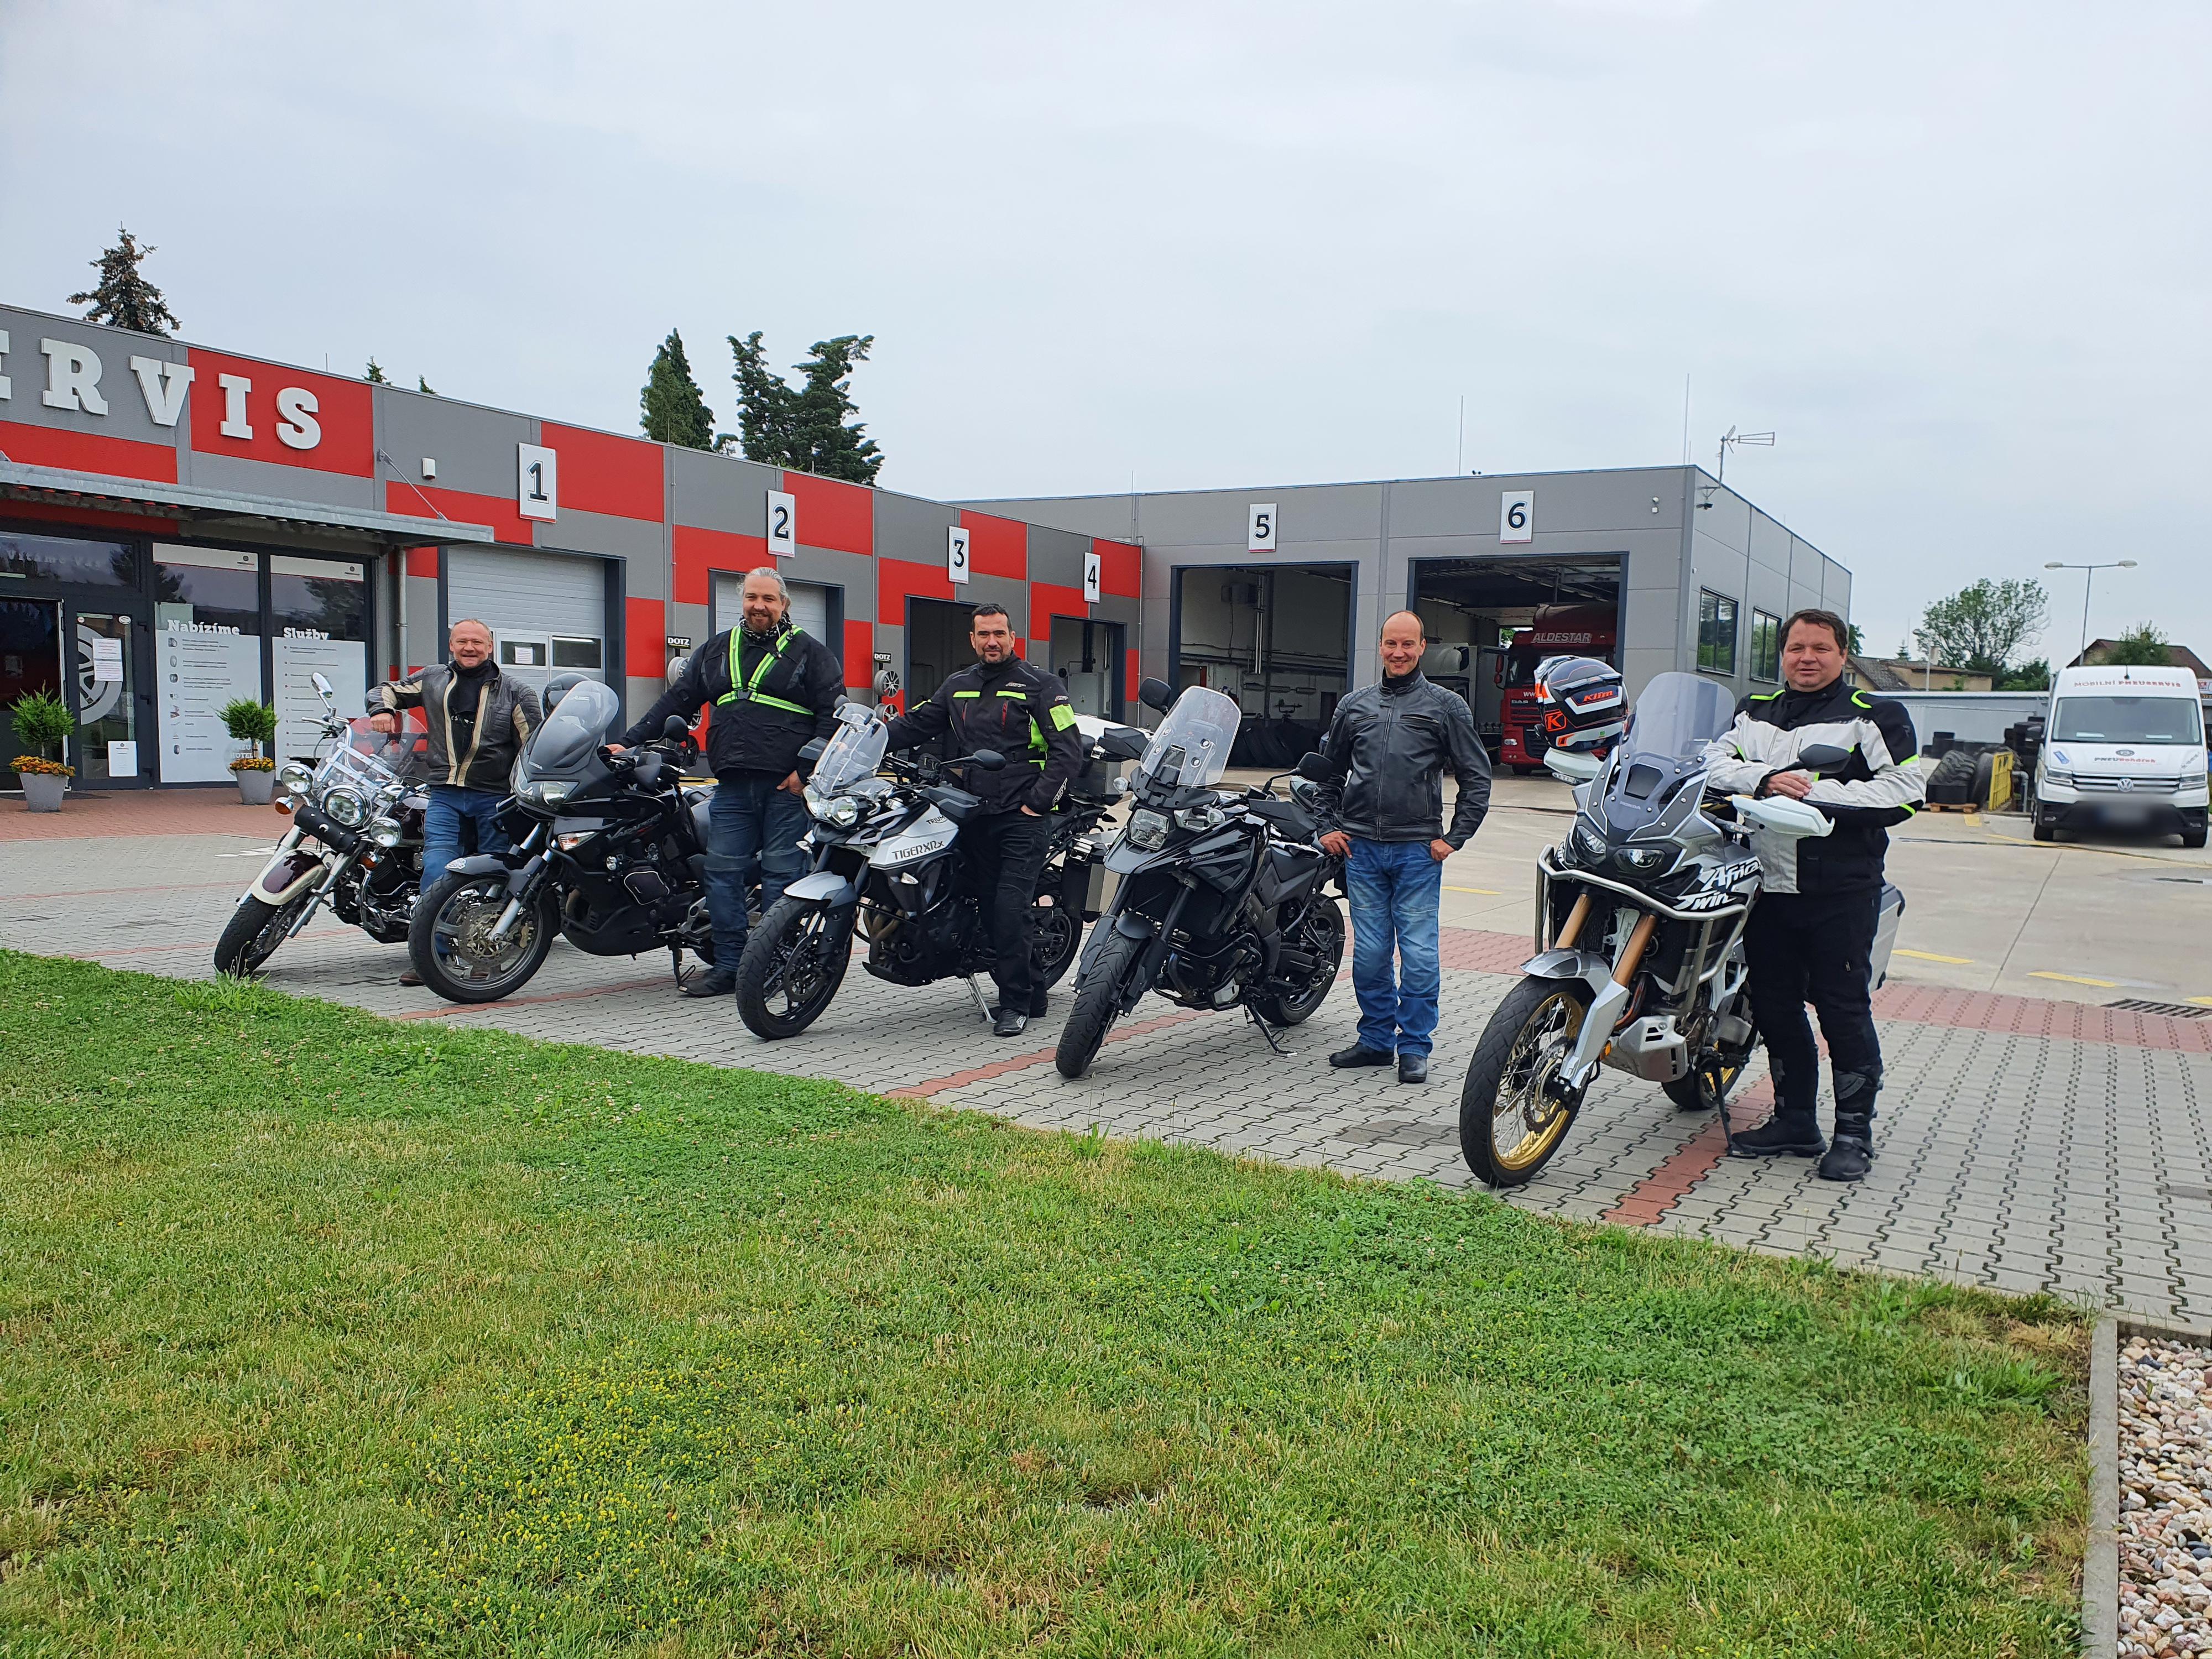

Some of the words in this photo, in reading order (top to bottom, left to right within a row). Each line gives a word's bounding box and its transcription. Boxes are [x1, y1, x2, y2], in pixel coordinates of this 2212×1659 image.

[0, 330, 322, 450] RVIS
[526, 460, 550, 504] 1
[772, 504, 791, 541] 2
[1254, 513, 1272, 540] 5
[1507, 500, 1527, 531] 6
[952, 539, 966, 570] 3
[1087, 563, 1098, 591] 4
[167, 619, 241, 635] Nabízíme
[283, 627, 329, 640] Služby
[1531, 632, 1593, 644] ALDESTAR
[667, 637, 690, 645] DOTZ
[1583, 691, 1613, 702] Klim
[1052, 778, 1068, 806] RST
[1619, 801, 1641, 810] HONDA
[926, 815, 947, 825] TRIUM
[1700, 856, 1762, 892] Africa
[1672, 890, 1737, 911] Twin
